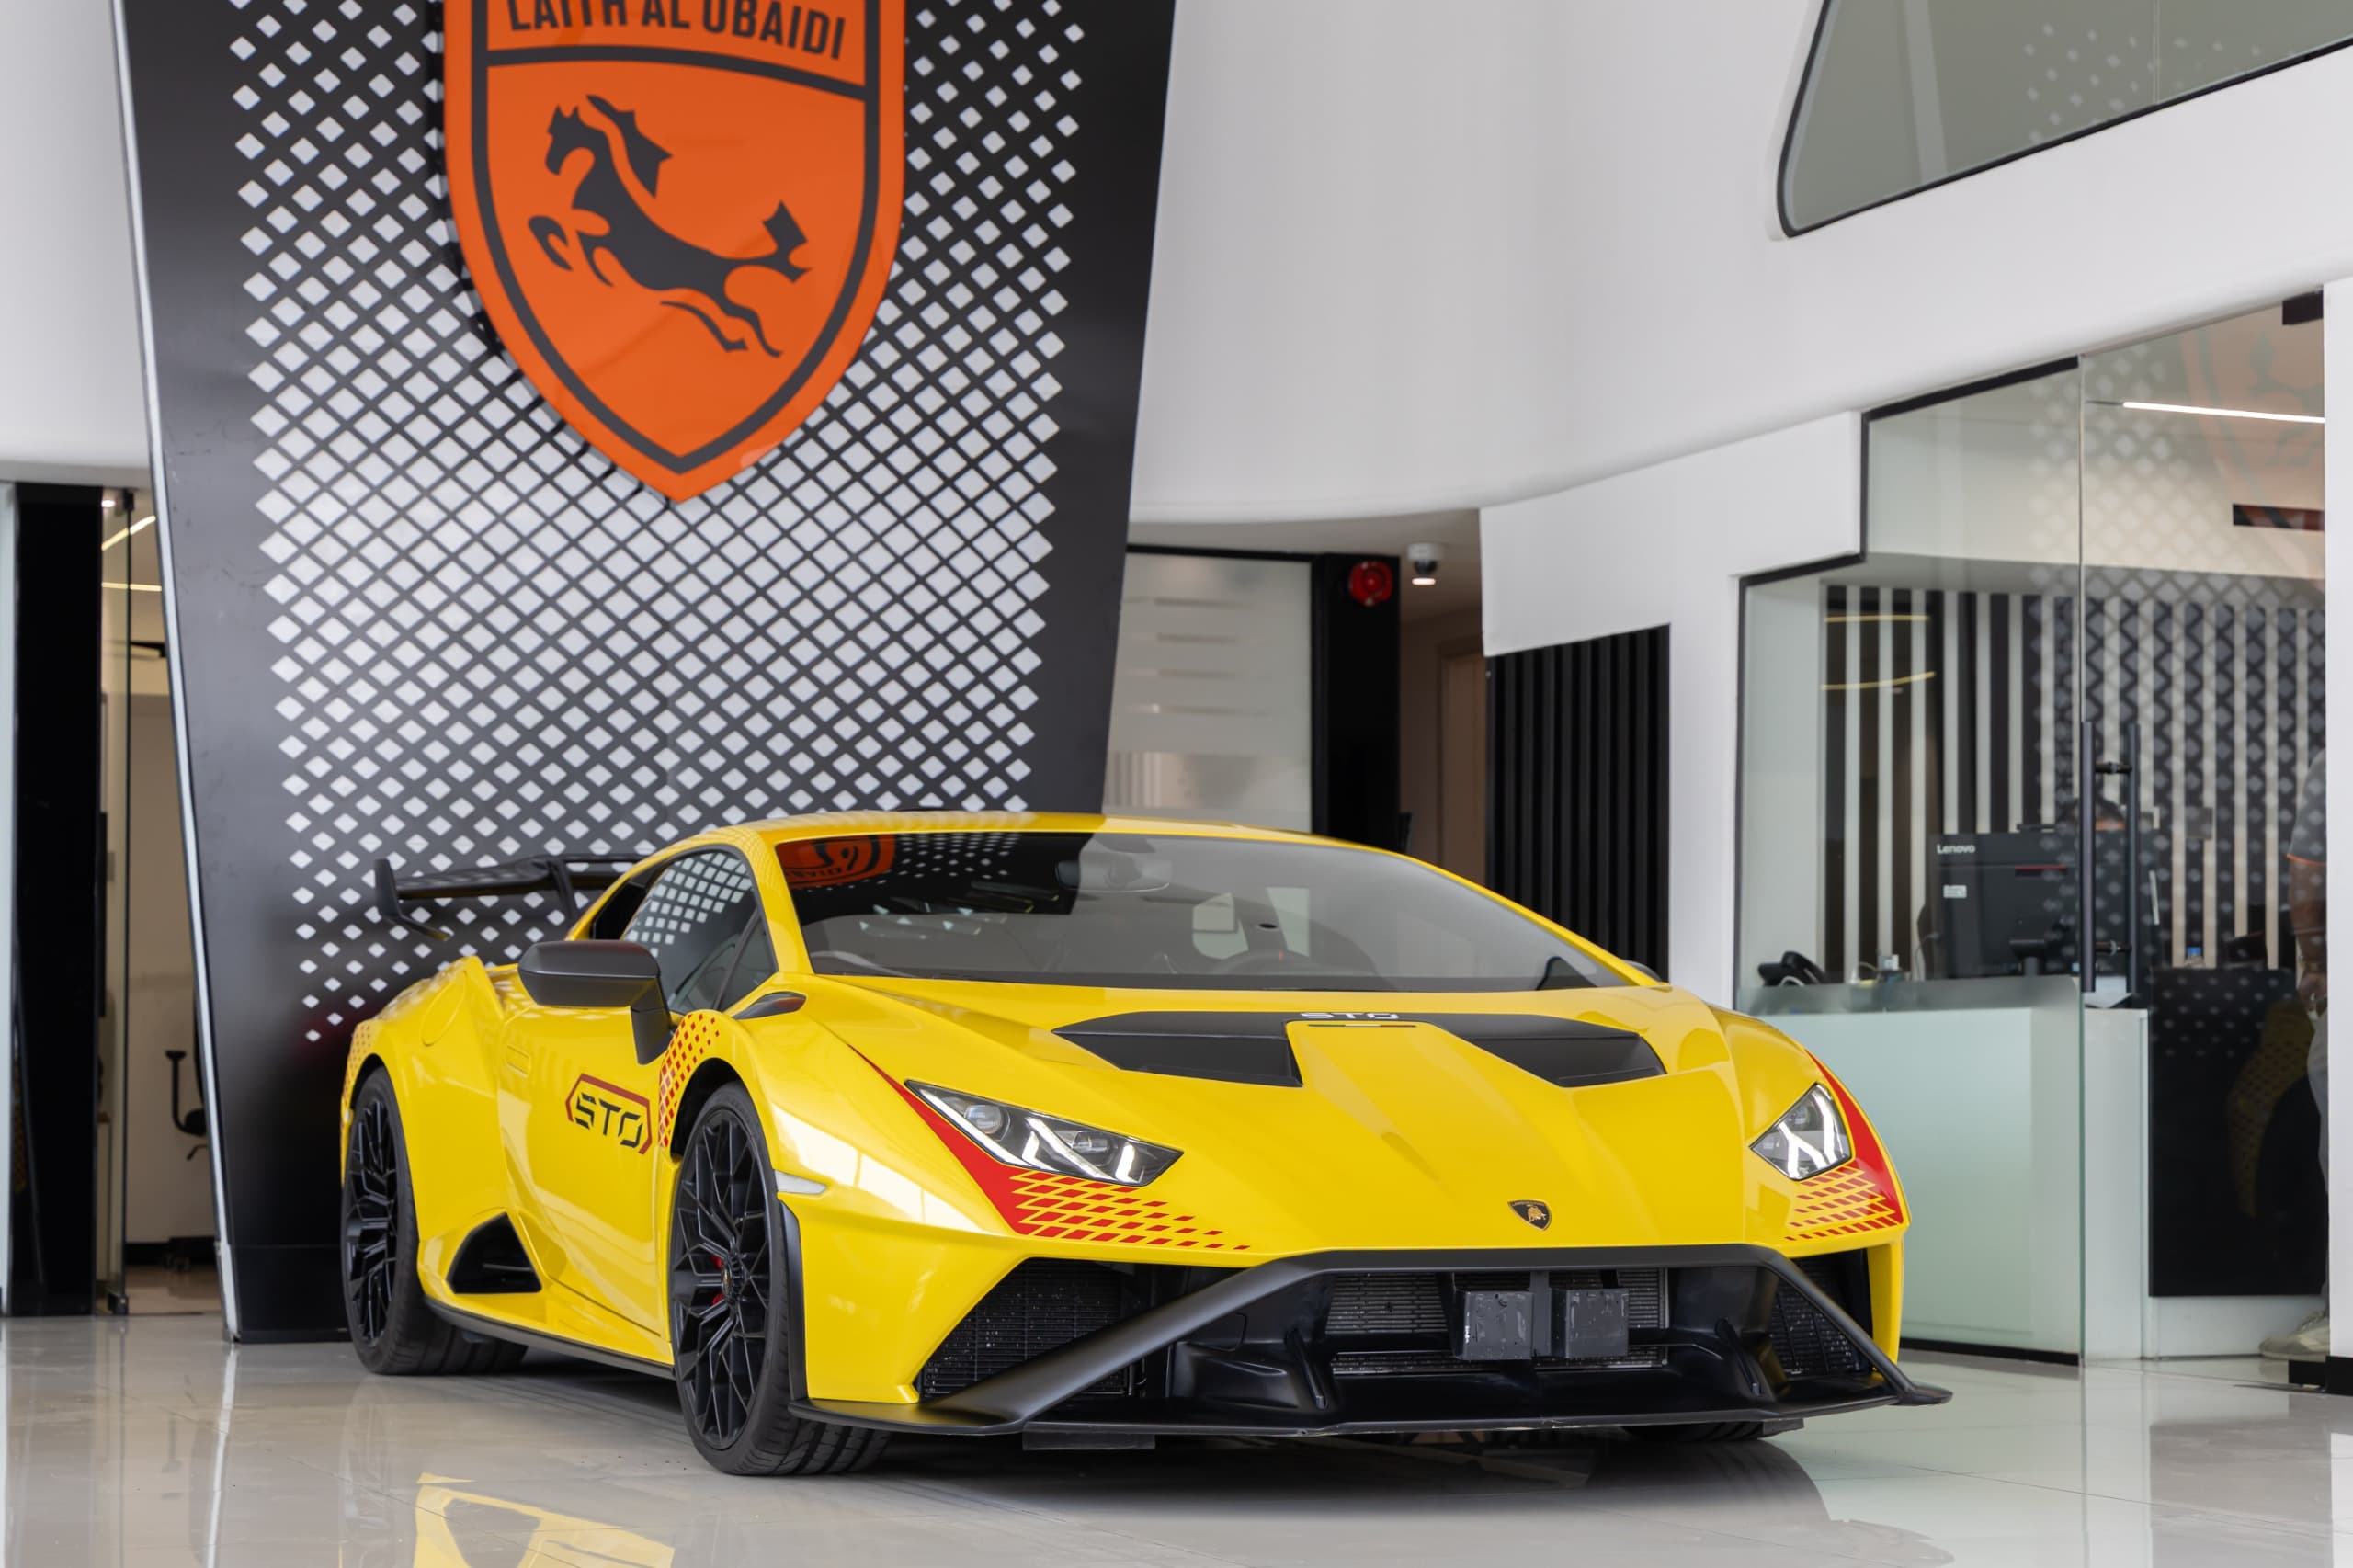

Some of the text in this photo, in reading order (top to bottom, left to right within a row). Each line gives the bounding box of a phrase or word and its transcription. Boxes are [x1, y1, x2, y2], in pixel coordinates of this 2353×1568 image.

[507, 0, 846, 60] LAITH AL OBAIDI
[1937, 843, 1975, 854] Lenovo
[575, 1092, 643, 1148] STO
